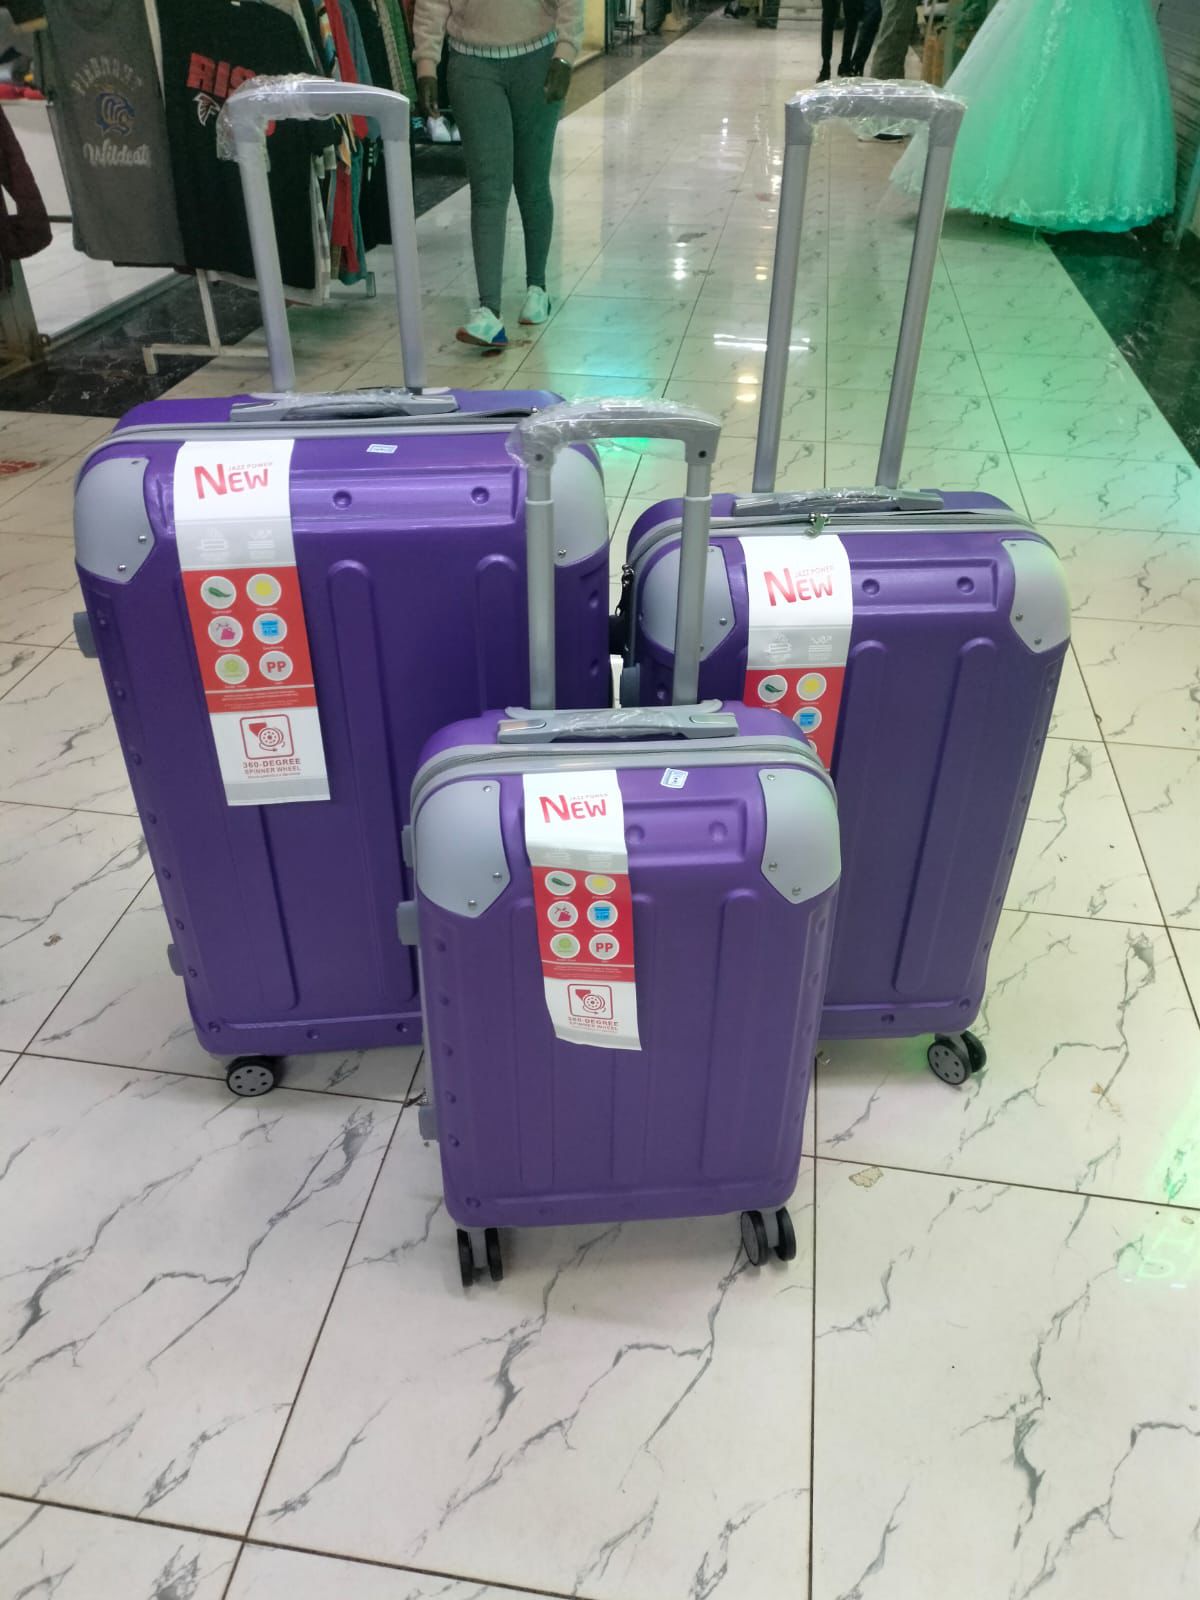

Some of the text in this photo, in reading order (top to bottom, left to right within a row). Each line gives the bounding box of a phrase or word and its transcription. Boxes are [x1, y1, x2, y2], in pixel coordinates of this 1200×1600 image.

[266, 661, 287, 673] PP
[242, 758, 302, 769] 360-DEGREE
[244, 765, 302, 775] SPINNER WHEEL
[595, 942, 614, 953] PP
